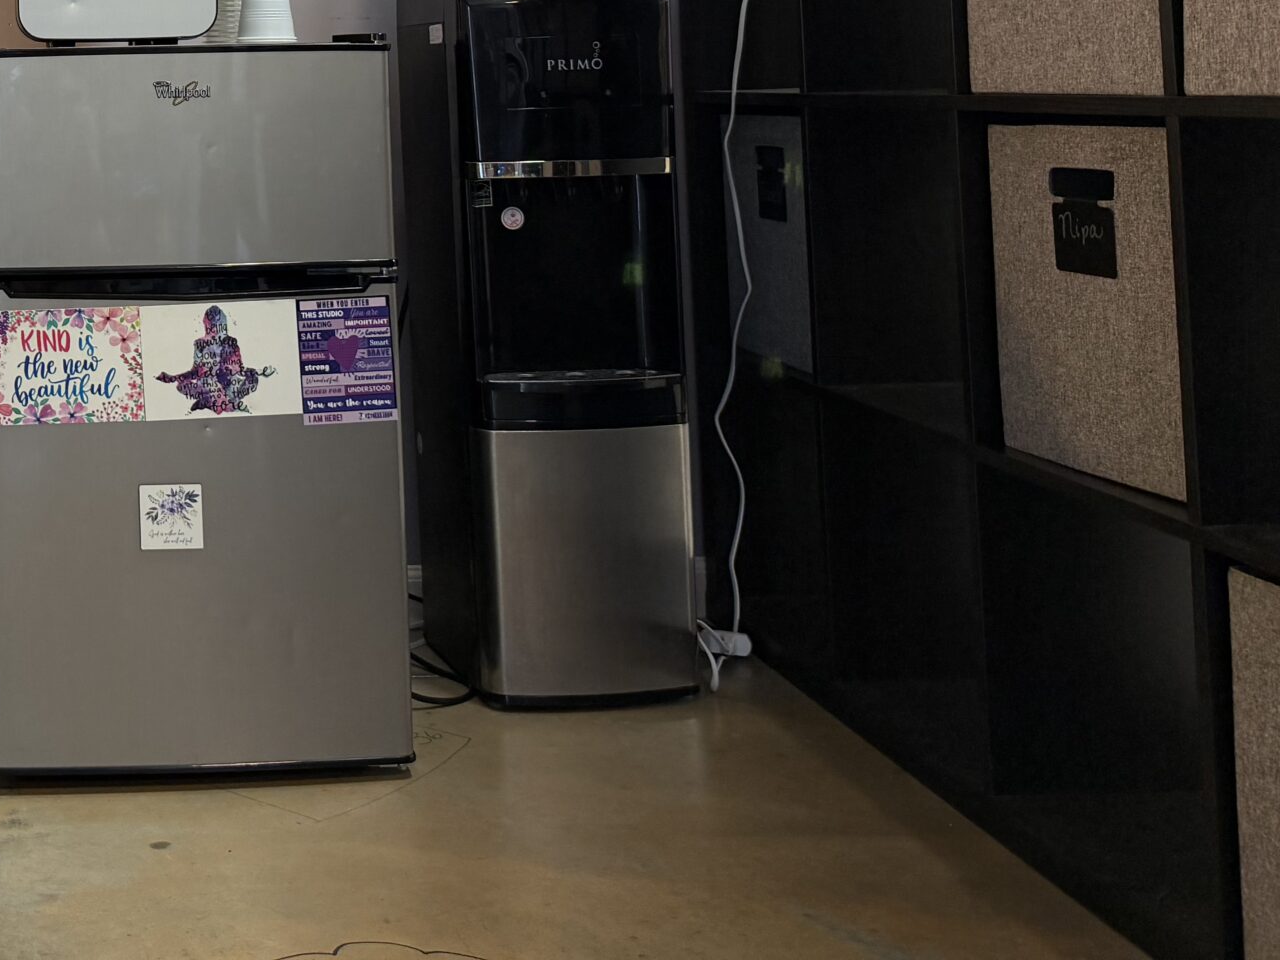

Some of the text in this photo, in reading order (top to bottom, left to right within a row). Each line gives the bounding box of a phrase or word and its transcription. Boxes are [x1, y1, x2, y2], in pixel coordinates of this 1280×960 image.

[547, 57, 603, 71] PRIMO
[153, 81, 211, 103] Whirlpool
[318, 310, 344, 318] STUDIO
[20, 329, 97, 356] KIND is
[301, 332, 321, 340] SAFE
[17, 352, 103, 380] the new
[12, 368, 120, 407] beautiful
